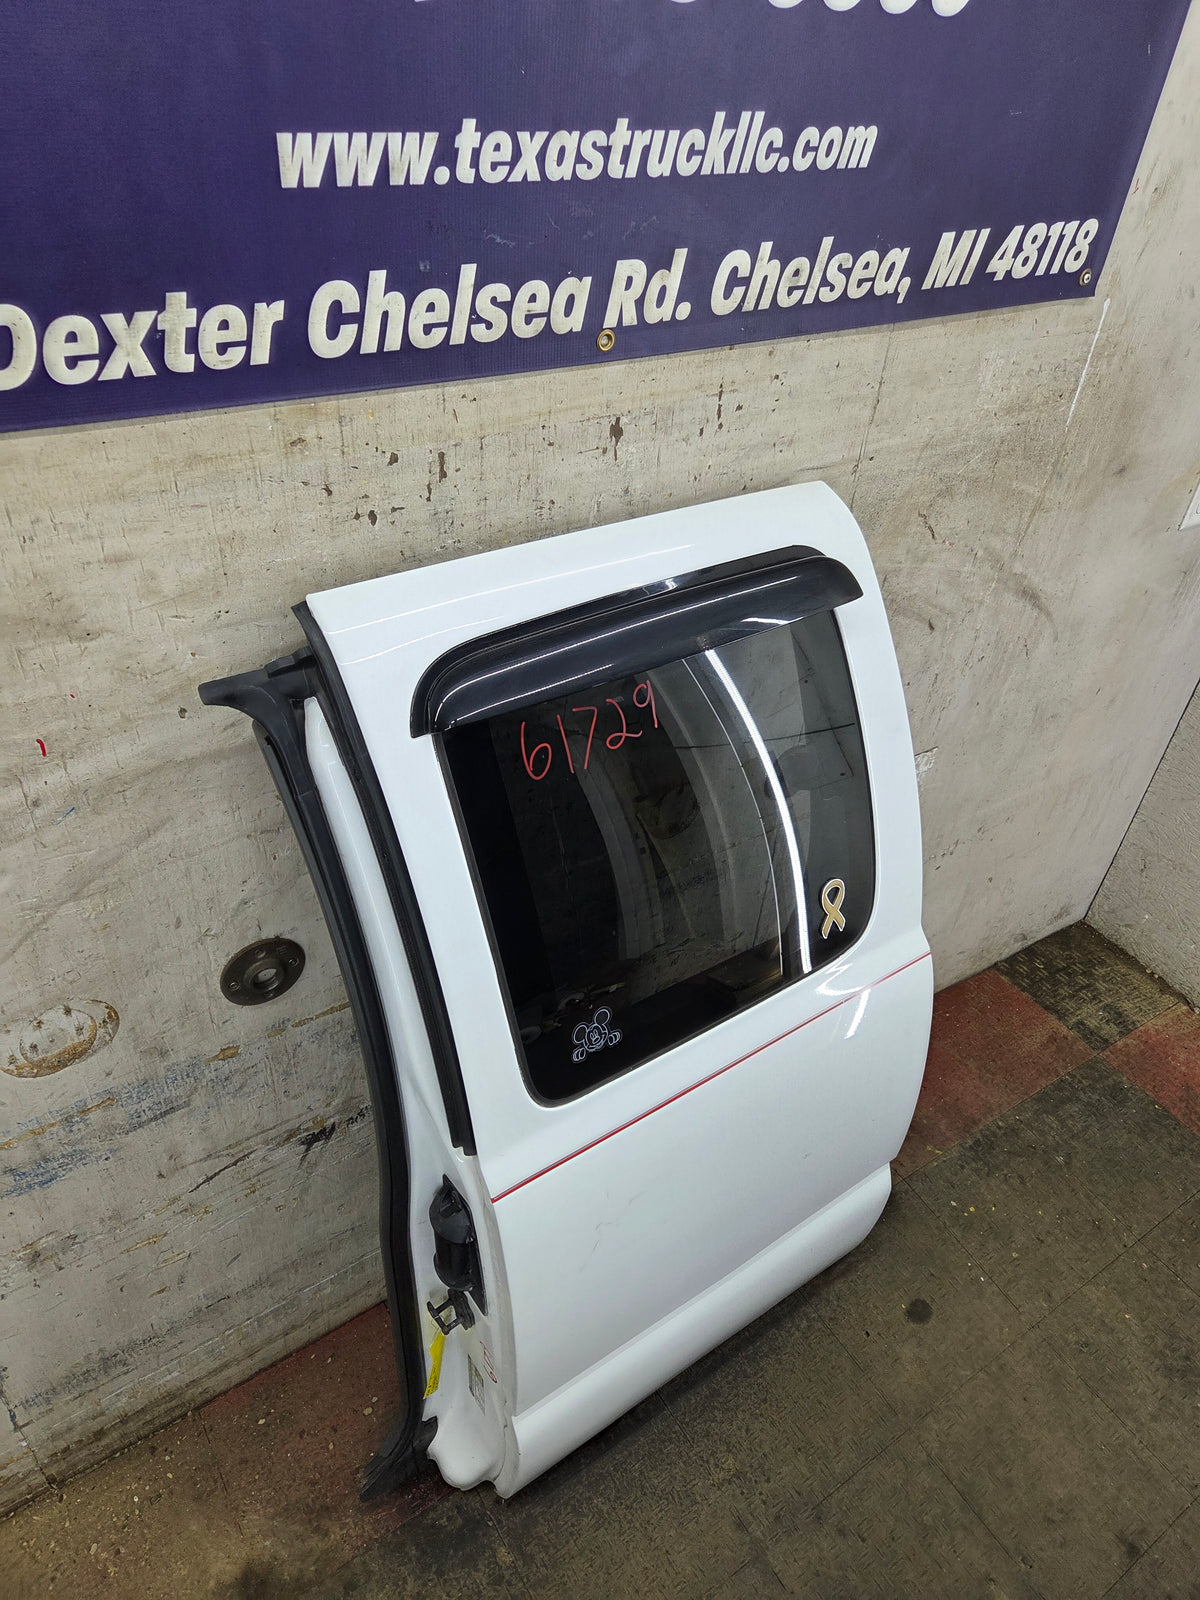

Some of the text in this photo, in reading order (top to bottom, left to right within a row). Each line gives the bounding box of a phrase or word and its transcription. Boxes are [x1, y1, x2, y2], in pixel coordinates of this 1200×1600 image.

[276, 110, 879, 189] www.texastruckllc.com
[307, 262, 593, 359] Chelsea
[603, 247, 692, 329] Rd.
[710, 236, 912, 316] Chelsea,
[921, 227, 992, 291] MI
[986, 217, 1099, 283] 48118
[520, 680, 658, 781] 61729
